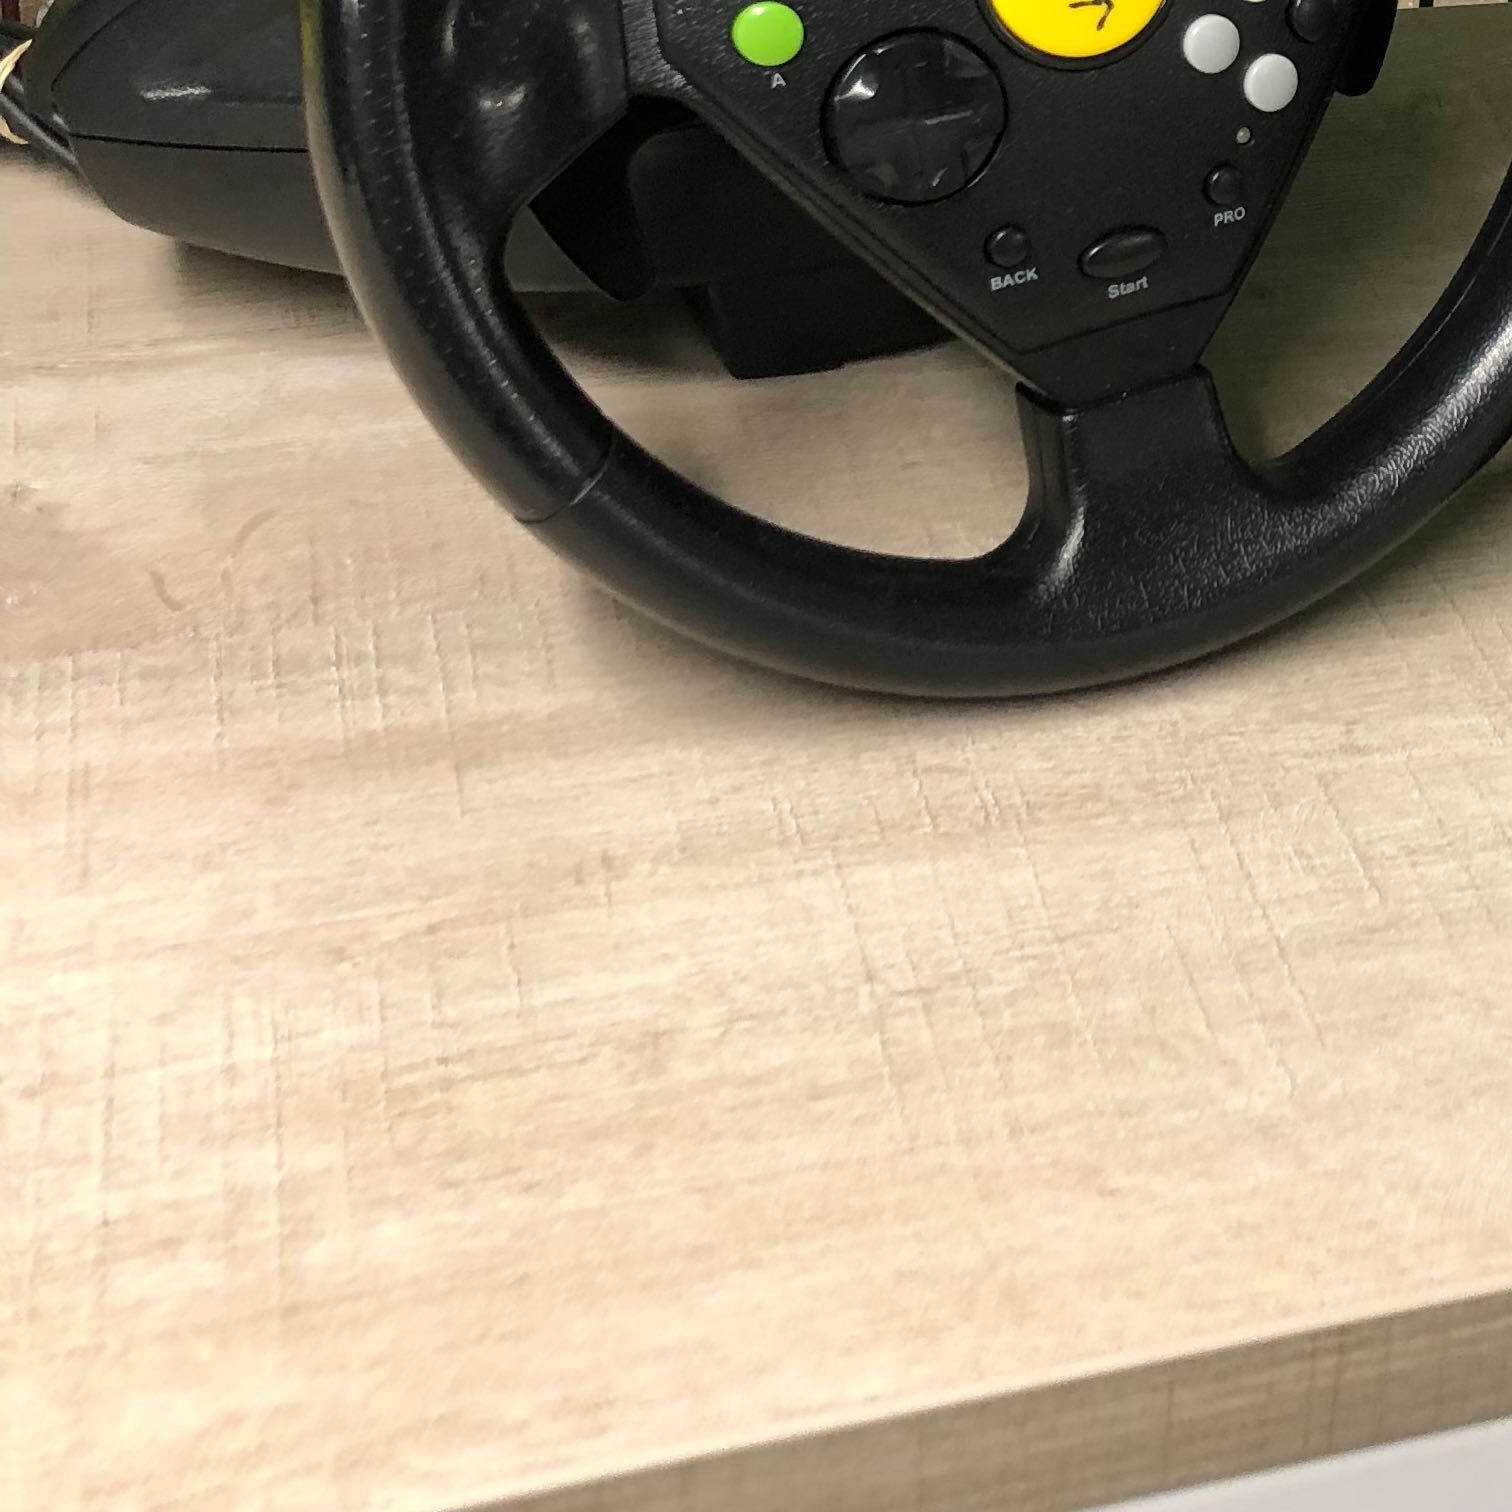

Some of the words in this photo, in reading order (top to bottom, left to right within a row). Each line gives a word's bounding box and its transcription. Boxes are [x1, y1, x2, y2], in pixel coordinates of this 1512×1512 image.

[770, 72, 787, 88] A
[1213, 206, 1246, 227] PRO
[989, 266, 1039, 292] BACK
[1107, 275, 1149, 300] Start
